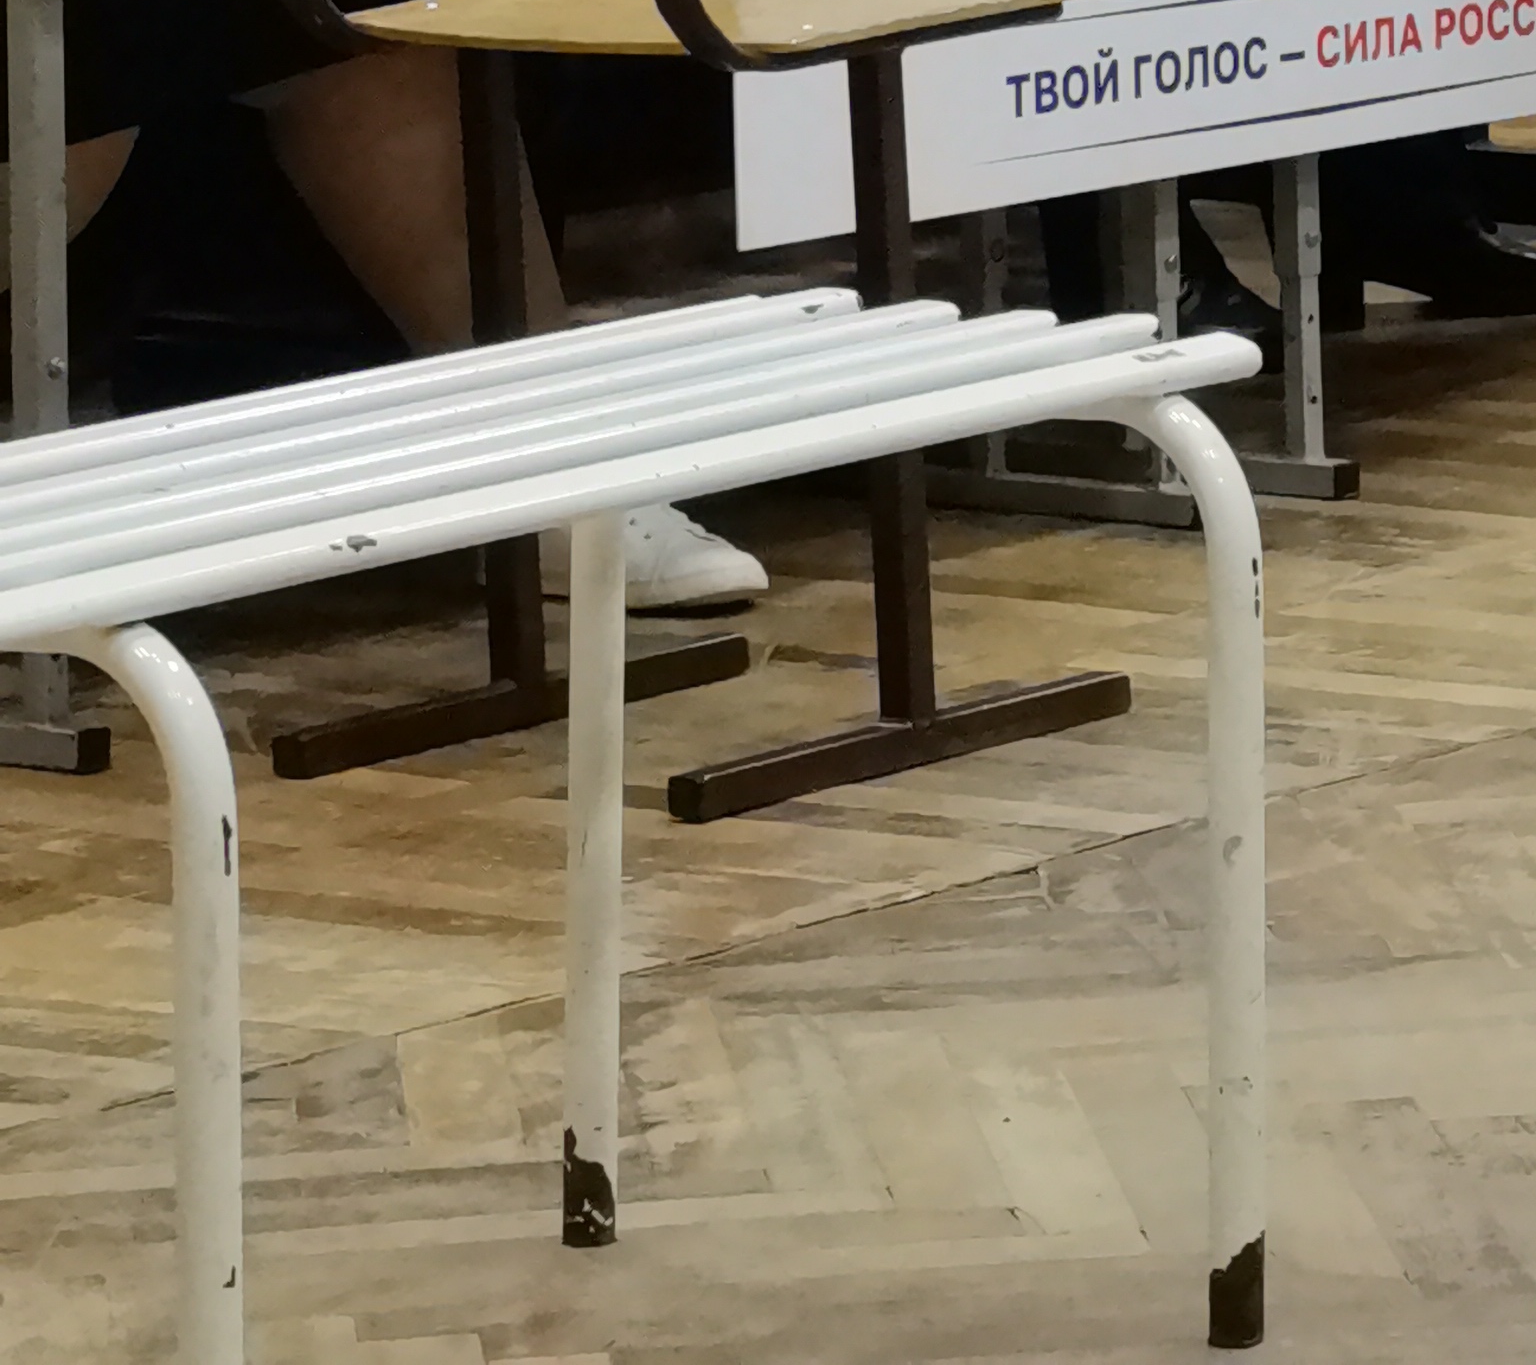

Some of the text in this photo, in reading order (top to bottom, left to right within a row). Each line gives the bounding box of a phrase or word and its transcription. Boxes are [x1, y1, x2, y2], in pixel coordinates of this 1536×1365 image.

[1004, 45, 1121, 119] ТВОЙ
[1132, 35, 1270, 101] ГОЛОС
[1315, 12, 1424, 70] СИЛА
